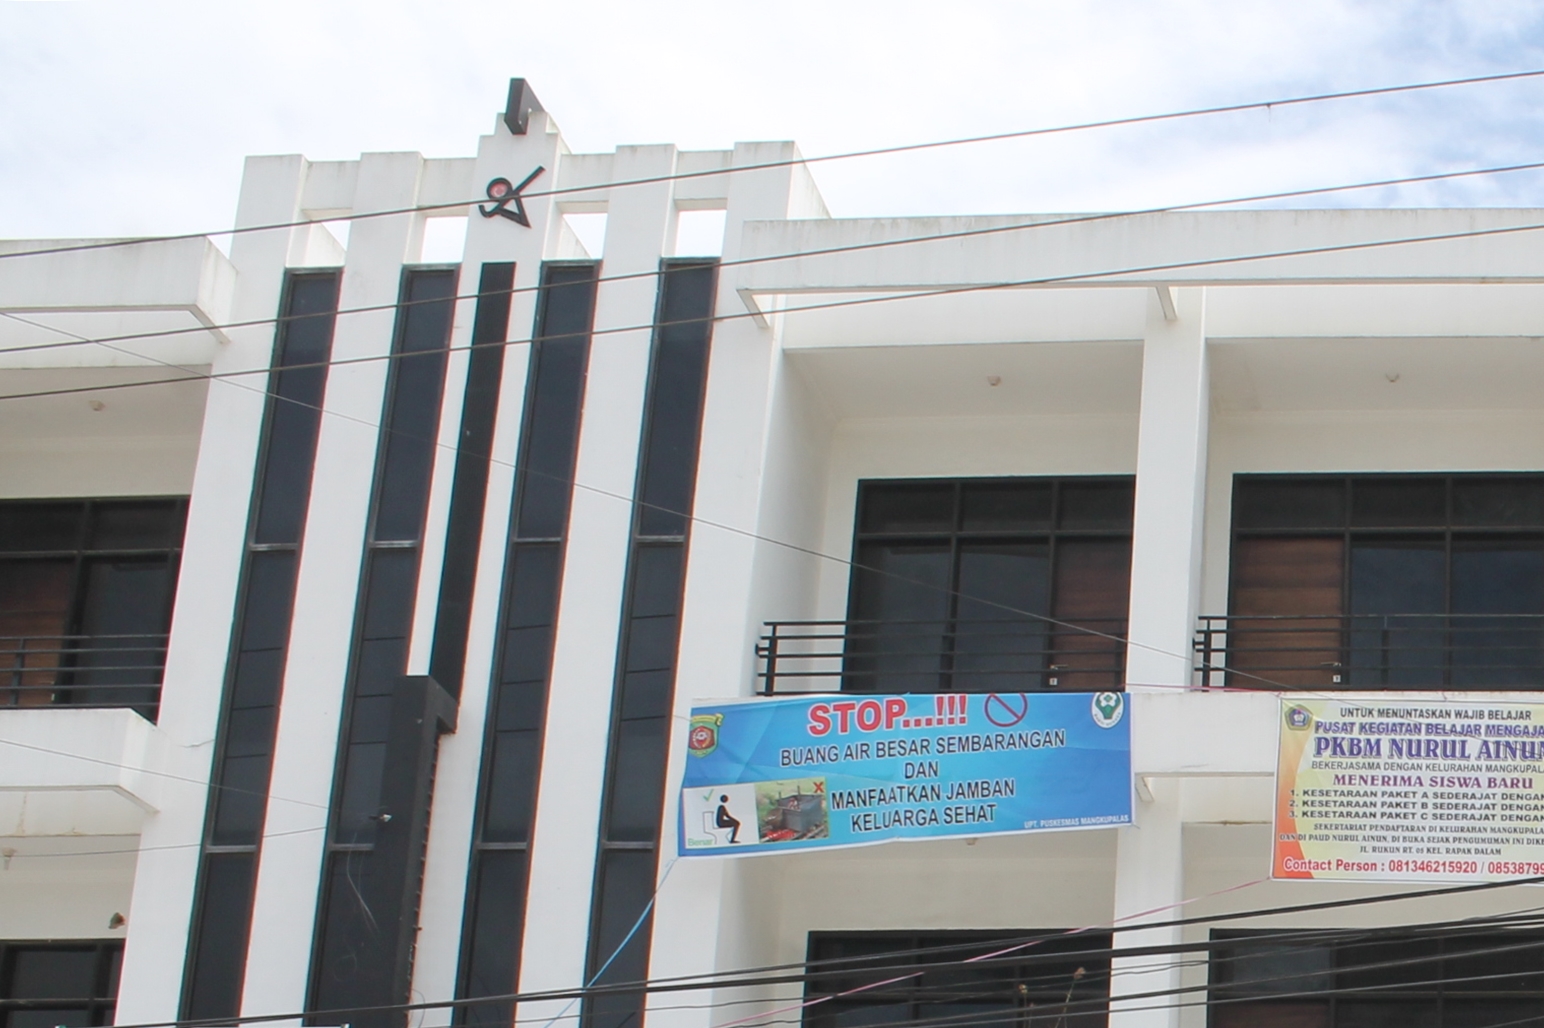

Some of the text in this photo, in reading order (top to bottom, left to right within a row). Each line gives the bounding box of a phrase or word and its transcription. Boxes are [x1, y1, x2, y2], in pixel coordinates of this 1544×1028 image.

[1340, 707, 1530, 721] UNTUK MENUNTASKAN WAJIB BELAJAR
[1314, 721, 1355, 735] PUSAT
[1359, 722, 1421, 736] KEGIATAN
[1425, 723, 1481, 737] BELAJAR
[781, 730, 1064, 767] BUANG AIR BESAR SEMBARANGAN
[1314, 737, 1382, 759] PKBM
[1388, 738, 1471, 760] NURUL
[903, 761, 941, 780] DAN
[1311, 762, 1381, 772] BEKERJASAMA
[1383, 763, 1422, 772] DENGAN
[1425, 763, 1482, 773] KELURAHAN
[1333, 774, 1532, 789] MENERIMA SISWA BARU
[831, 779, 1014, 810] MANFAATKAN JAMBAN
[1303, 789, 1377, 799] KESETARAAN
[1381, 790, 1416, 799] PAKET
[1422, 791, 1428, 799] A
[1433, 791, 1496, 801] SEDERAJAT
[1302, 800, 1377, 809] KESETARAAN
[1380, 801, 1415, 810] PAKET
[1421, 802, 1428, 810] B
[1433, 802, 1496, 811] SEDERAJAT
[852, 805, 995, 833] KELUARGA SEHAT
[1302, 810, 1376, 820] KESETARAAN
[1380, 812, 1415, 820] PAKET
[1420, 812, 1427, 821] C
[1432, 812, 1495, 822] SEDERAJAT
[1314, 823, 1366, 832] SEKERTARIAT
[1369, 824, 1426, 833] PENDAFTARAN
[1428, 825, 1437, 833] DI
[1439, 825, 1487, 834] KELURAHAN
[1284, 857, 1332, 872] Contact
[1336, 859, 1377, 873] Person
[1388, 860, 1477, 874] 081346215920
